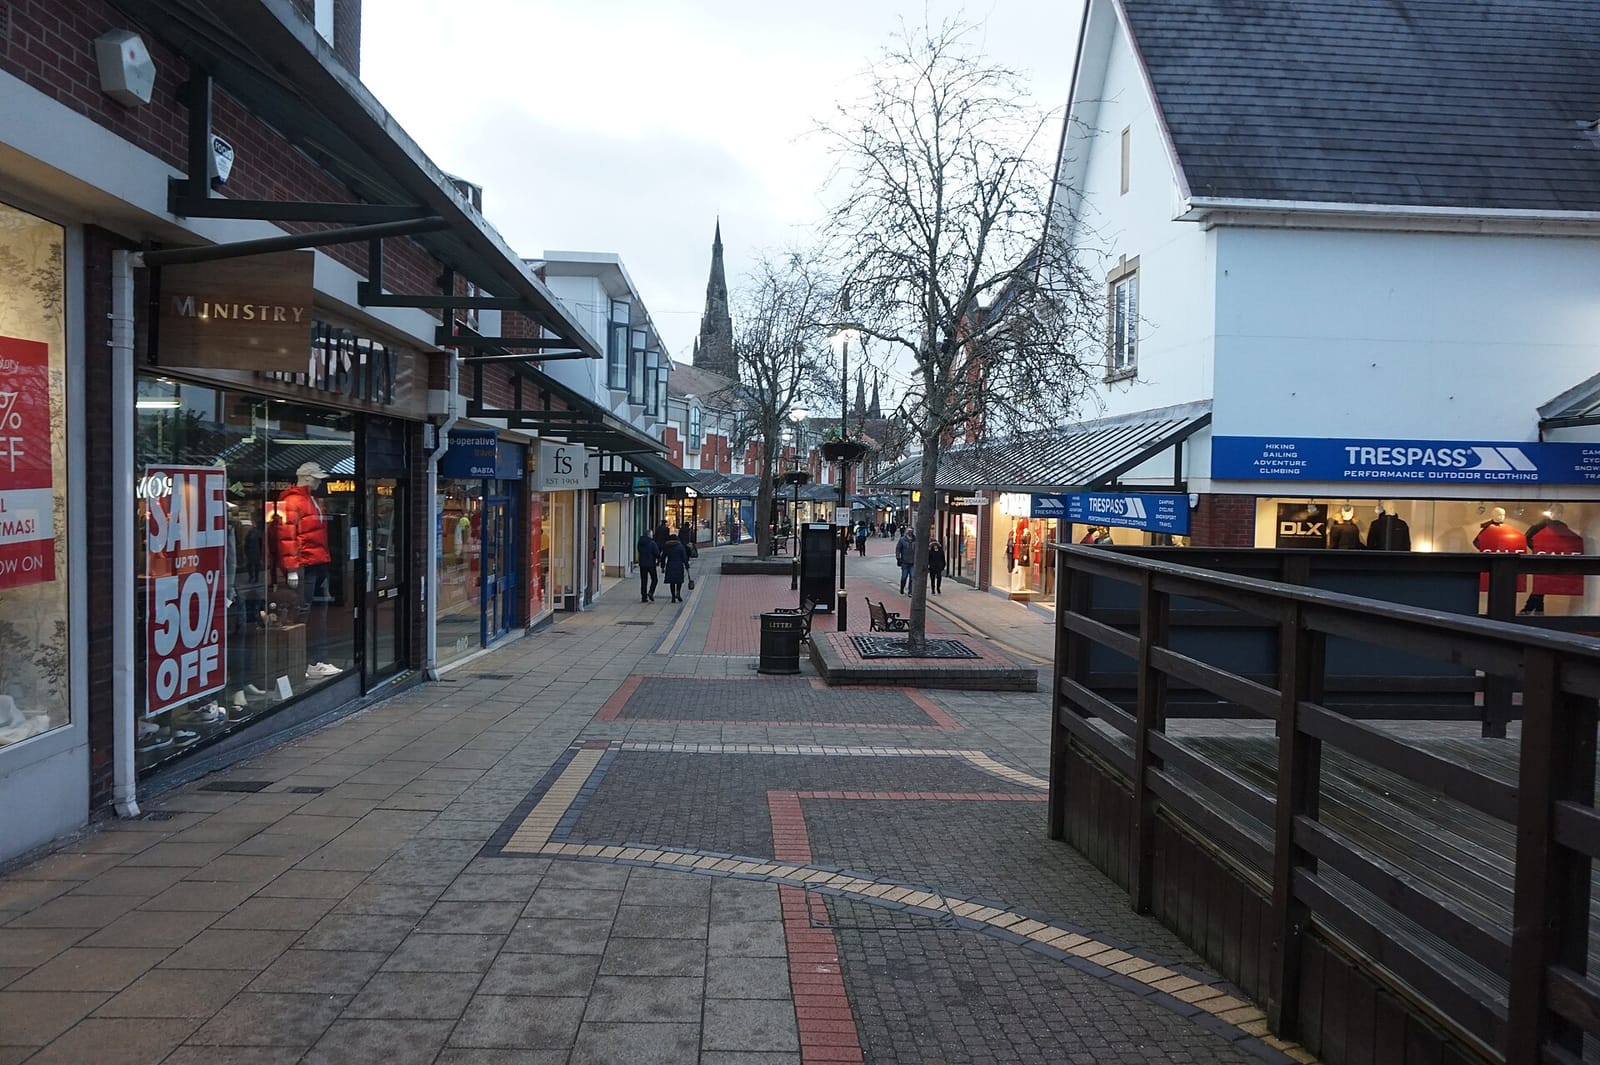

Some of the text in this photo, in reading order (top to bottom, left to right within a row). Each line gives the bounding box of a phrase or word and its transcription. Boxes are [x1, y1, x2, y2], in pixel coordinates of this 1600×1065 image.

[174, 295, 304, 322] MINISTRY
[553, 447, 572, 475] fs
[1345, 446, 1467, 467] TRESPASS
[1344, 470, 1425, 478] PERFORMANCE
[1429, 471, 1481, 479] OUTDOOR
[149, 472, 224, 554] SALE
[1088, 497, 1124, 514] TRESPASS
[1280, 521, 1323, 536] DLX
[22, 554, 43, 572] ON
[175, 555, 199, 569] UP TO
[154, 570, 220, 656] 50%
[156, 644, 219, 701] OFF
